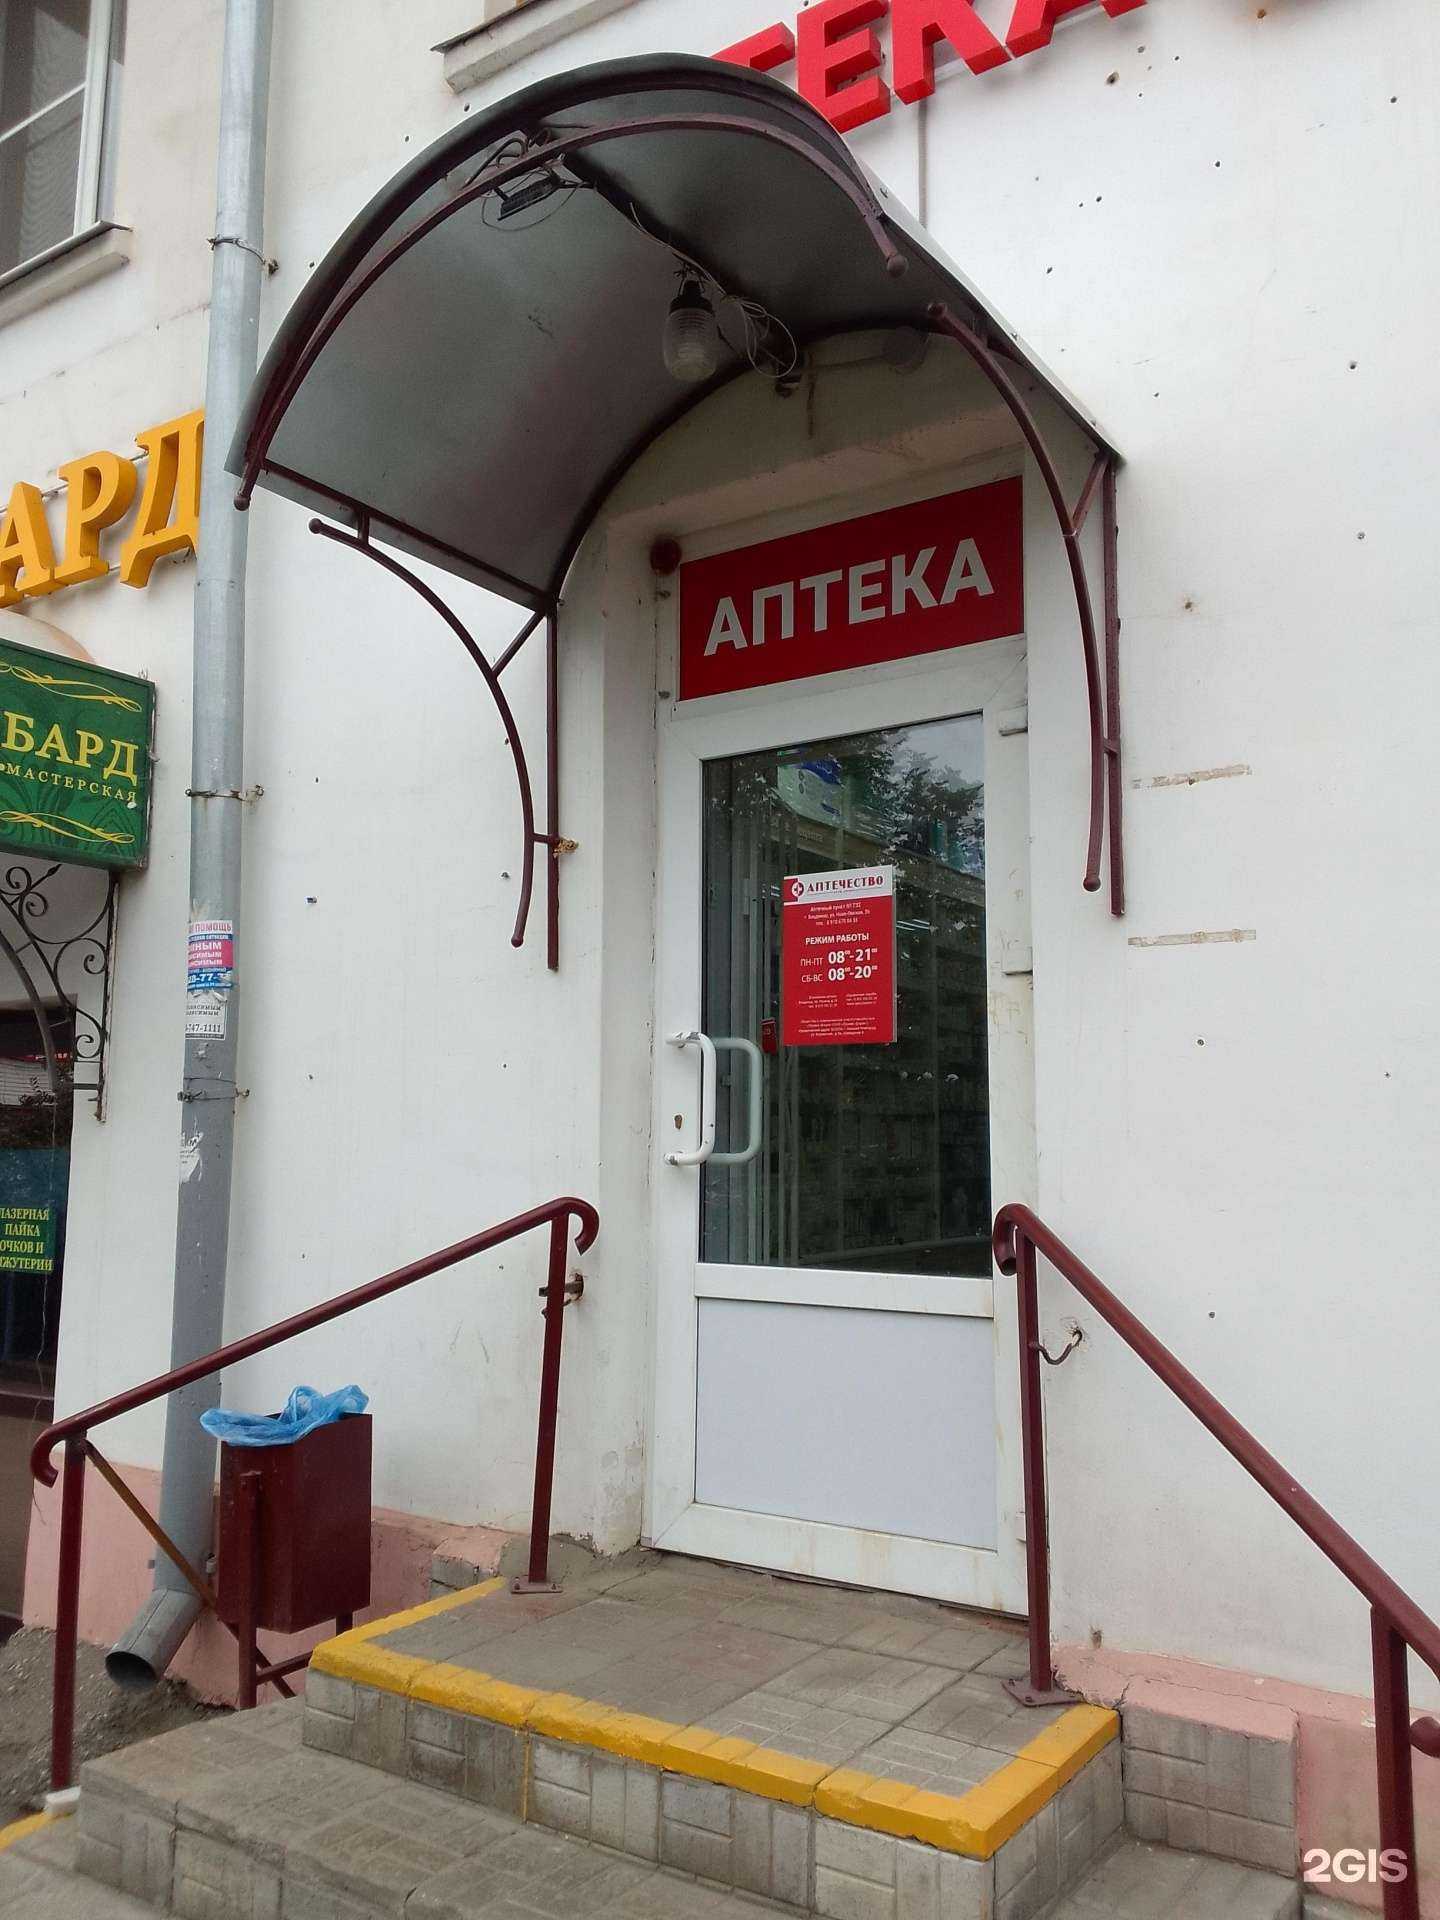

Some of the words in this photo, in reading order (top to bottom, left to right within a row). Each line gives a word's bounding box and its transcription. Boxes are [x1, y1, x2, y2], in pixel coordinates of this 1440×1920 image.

[0, 407, 205, 608] АРД
[703, 537, 995, 657] АПТЕКА
[1, 710, 139, 786] БАРД
[807, 875, 884, 893] АПТЕЧЕСТВО
[805, 935, 835, 945] РЕЖИМ
[836, 932, 869, 943] РАБОТЫ
[800, 957, 824, 967] ПН-ПТ
[801, 974, 823, 983] СБ-ВС
[5, 1221, 40, 1236] ПАЙКА
[0, 1240, 34, 1253] ОЧКОВ
[36, 1241, 44, 1254] И
